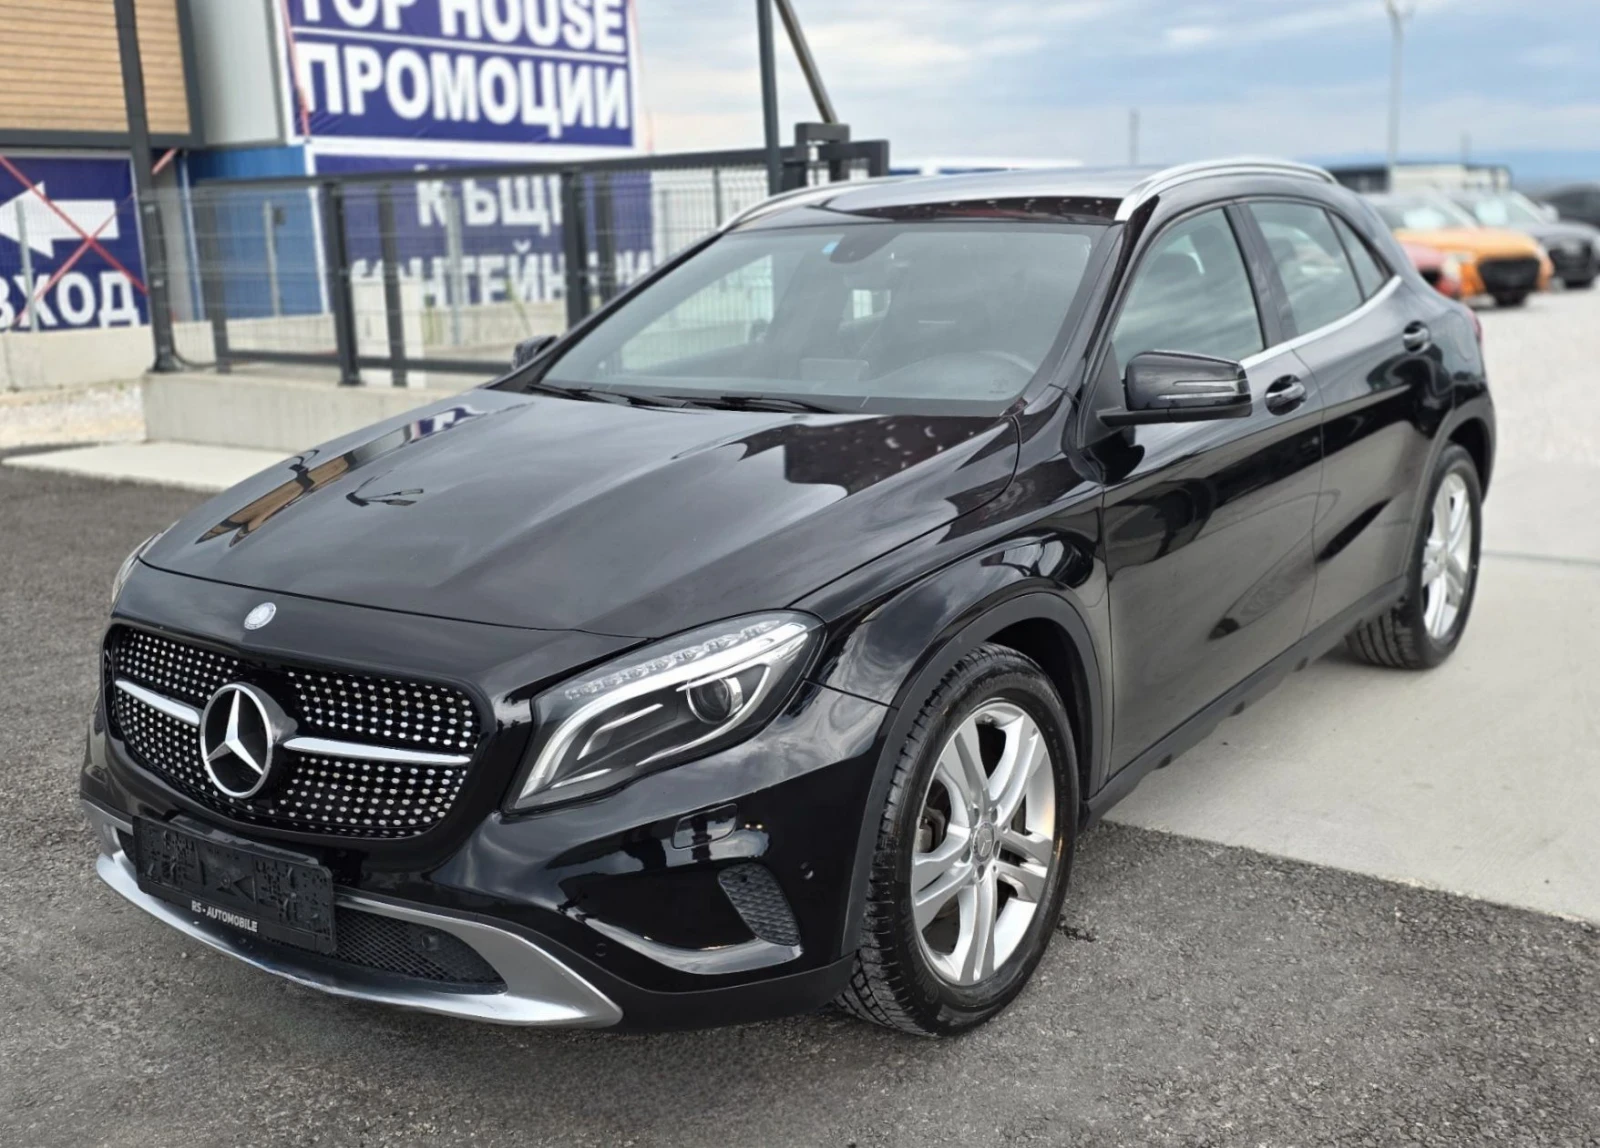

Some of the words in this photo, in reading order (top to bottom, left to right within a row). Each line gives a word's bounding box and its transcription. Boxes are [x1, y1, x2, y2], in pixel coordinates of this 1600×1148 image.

[438, 0, 627, 53] HOUSE
[295, 41, 630, 139] ПРОМОЦИИ
[206, 906, 258, 933] AUTOMOBILE
